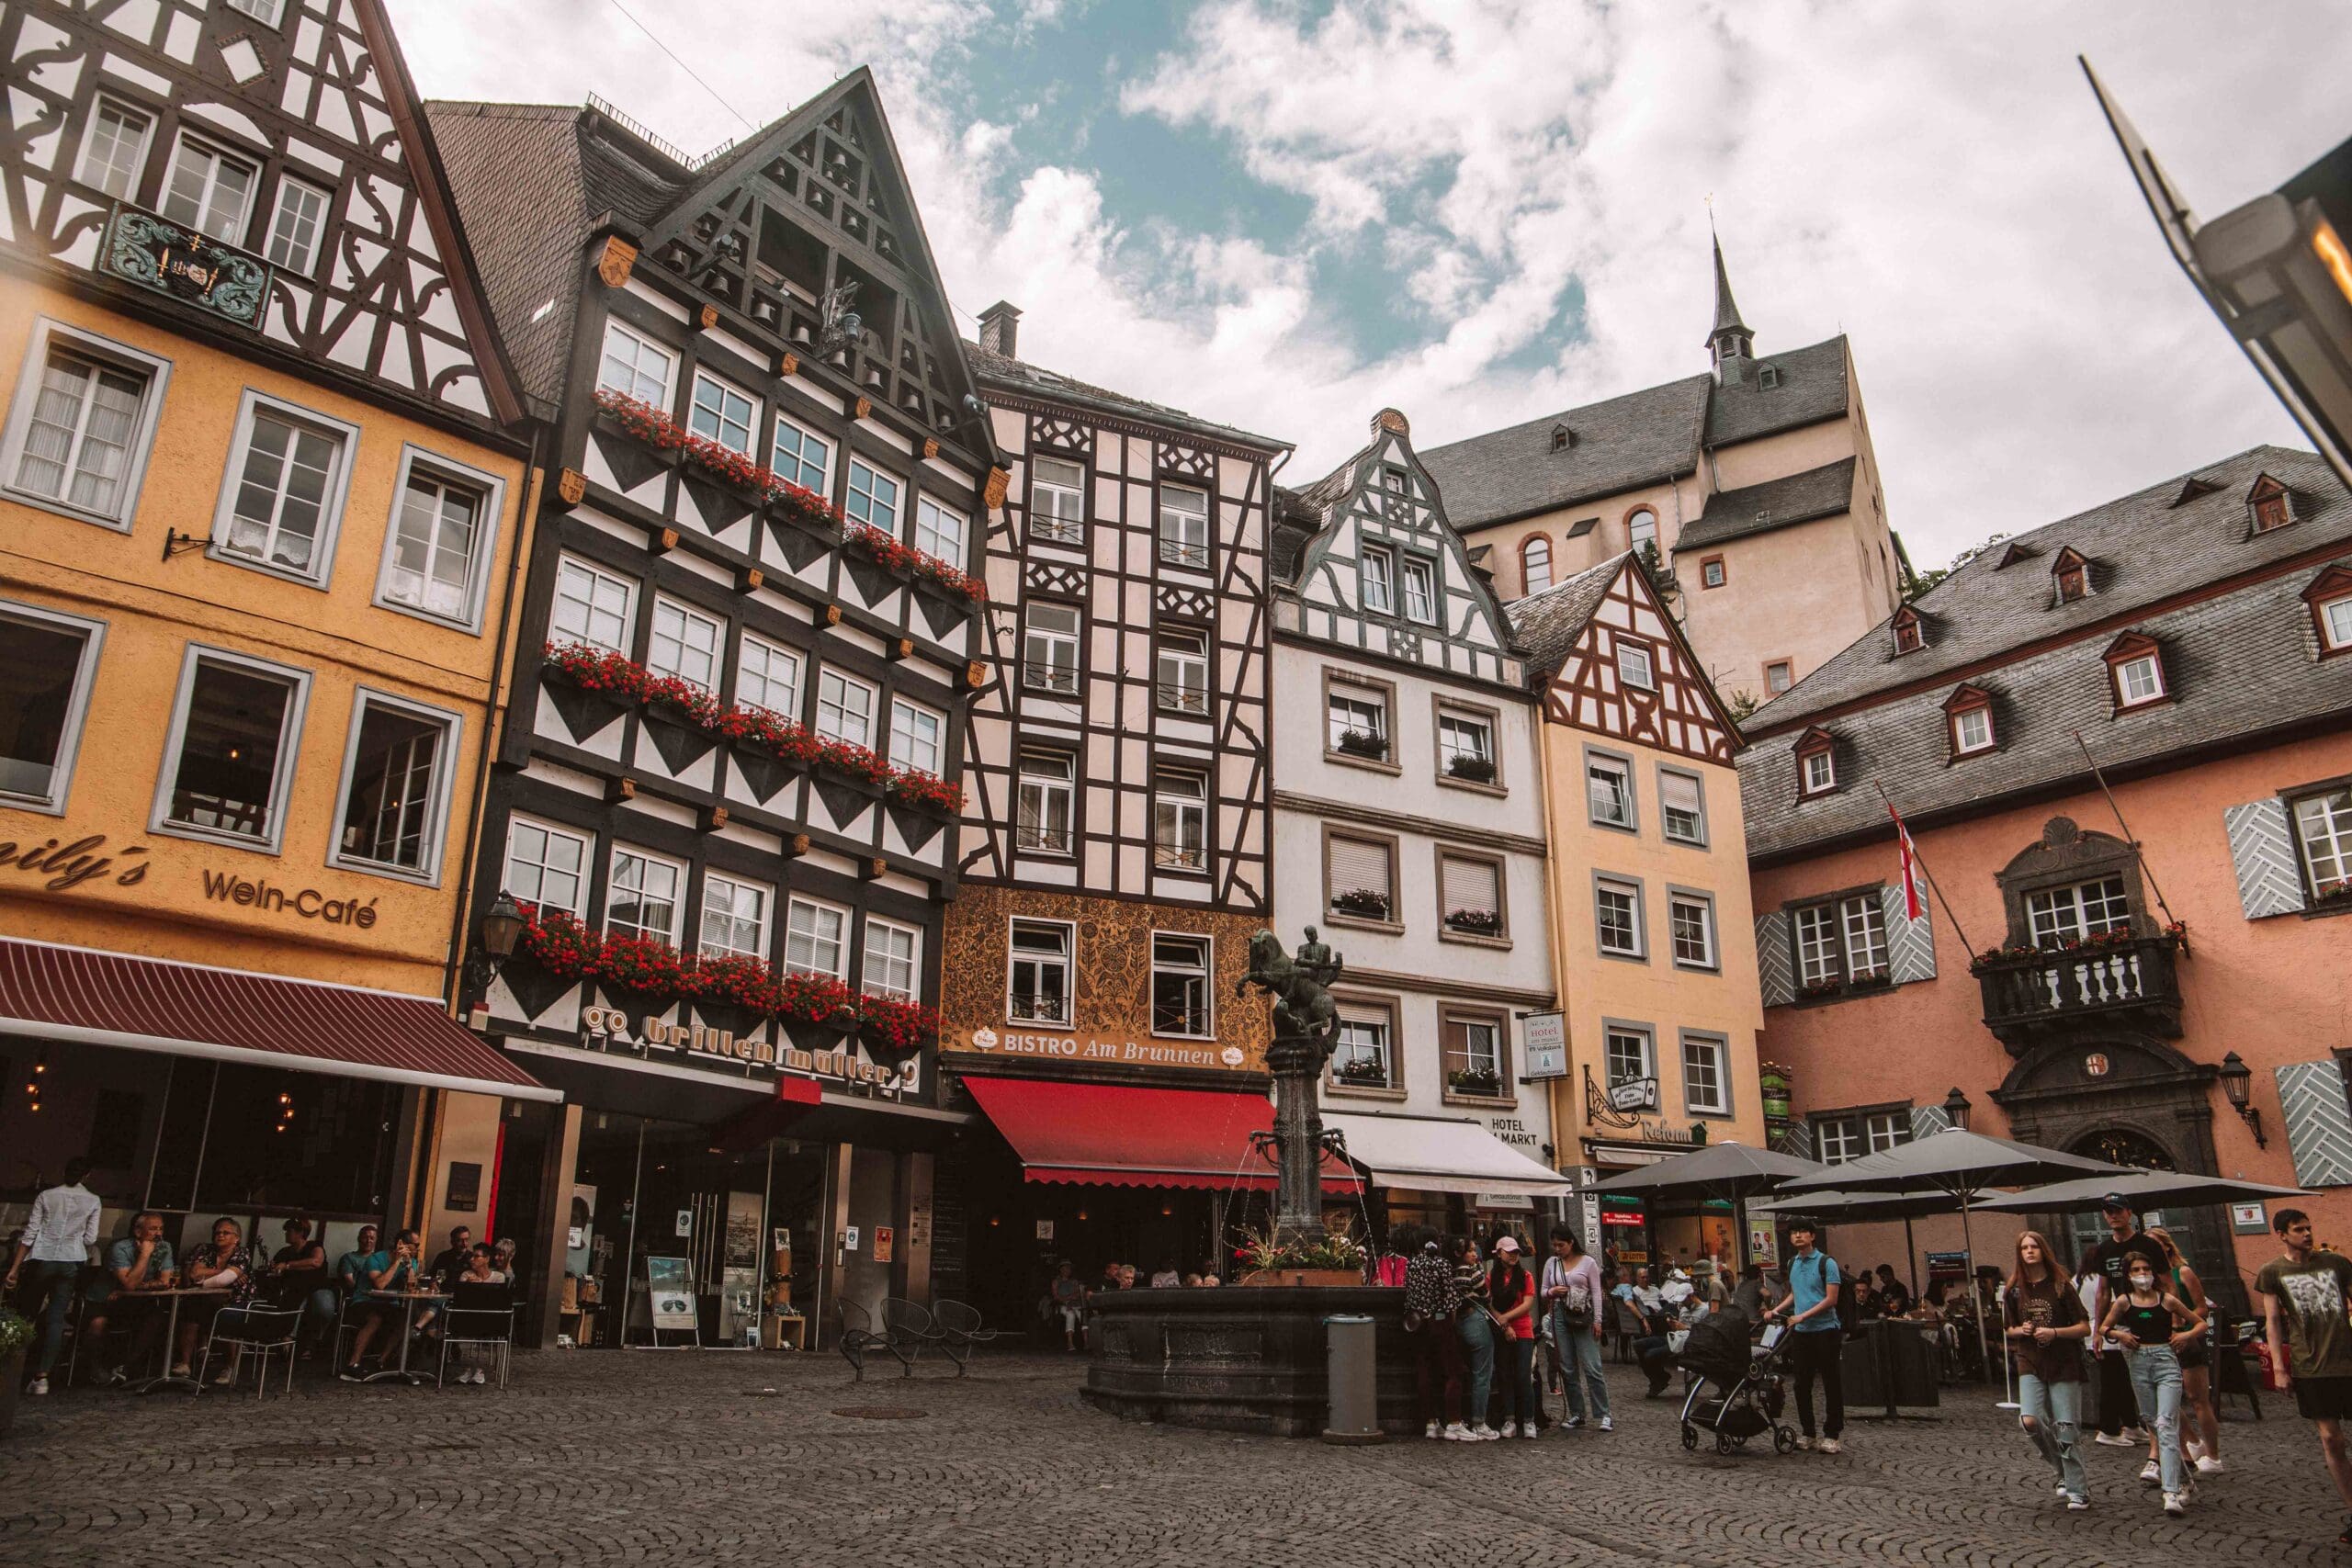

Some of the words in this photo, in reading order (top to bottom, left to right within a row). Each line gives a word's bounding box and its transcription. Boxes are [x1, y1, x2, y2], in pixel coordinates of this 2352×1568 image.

[202, 869, 379, 929] Wein-Café
[645, 1016, 774, 1064] brillen
[785, 1048, 892, 1084] müller
[1004, 1033, 1077, 1055] BISTRO
[1083, 1043, 1117, 1058] Am
[1123, 1043, 1215, 1066] Brunnen
[1492, 1118, 1525, 1132] HOTEL
[1501, 1133, 1537, 1145] MARKT
